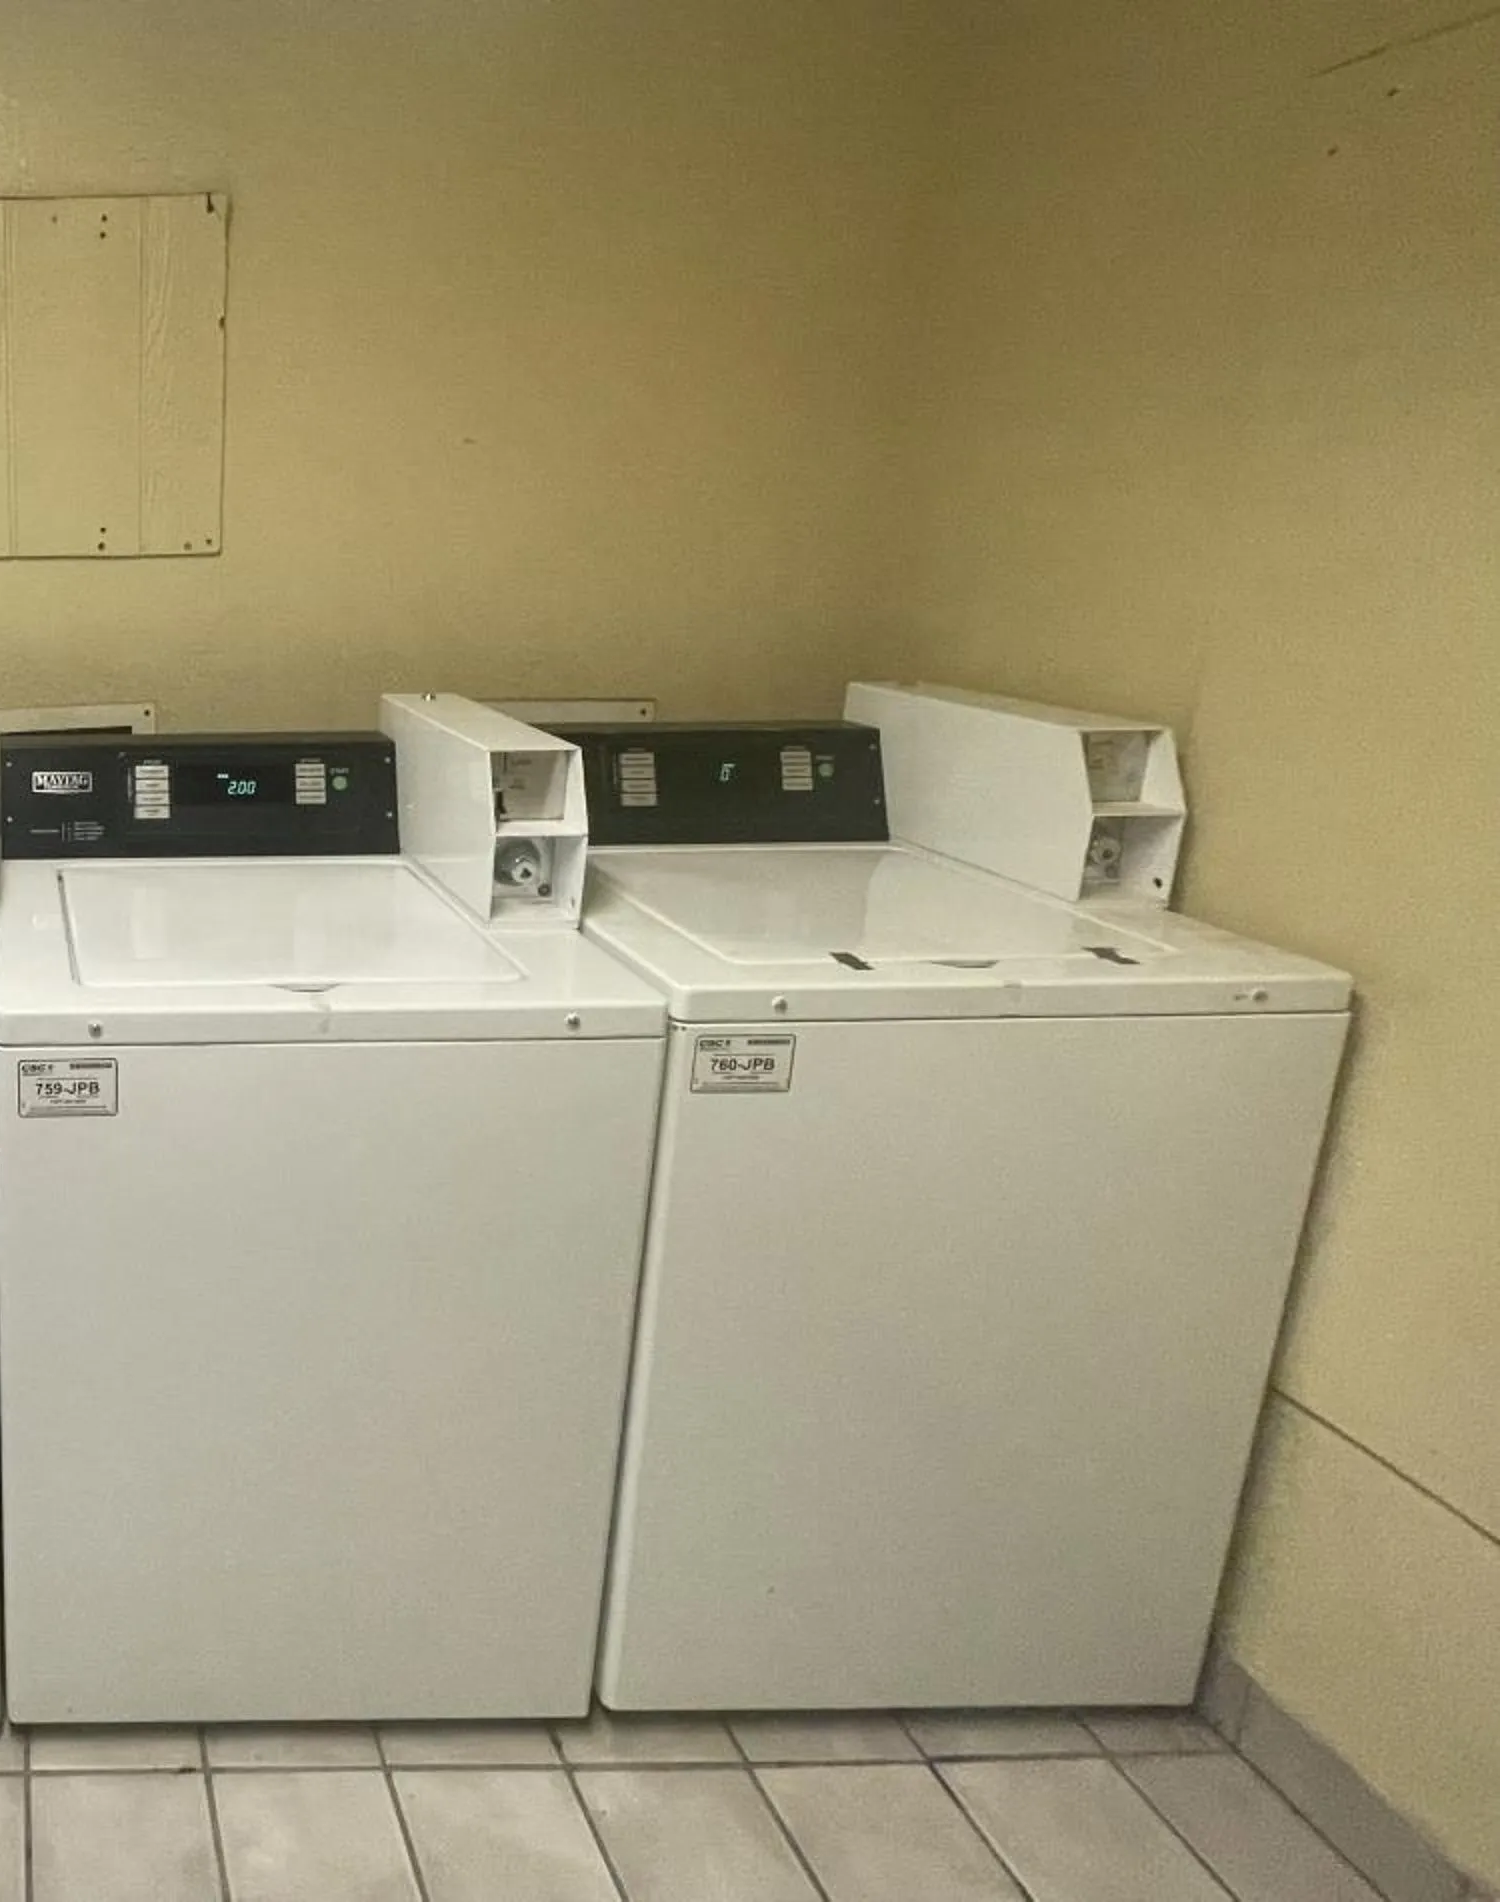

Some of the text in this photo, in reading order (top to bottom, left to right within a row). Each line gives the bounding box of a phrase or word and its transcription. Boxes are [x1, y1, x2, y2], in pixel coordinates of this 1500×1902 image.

[34, 774, 90, 791] MAYTAG
[711, 1058, 775, 1071] 760-JPB
[35, 1081, 101, 1095] 759-JPB
